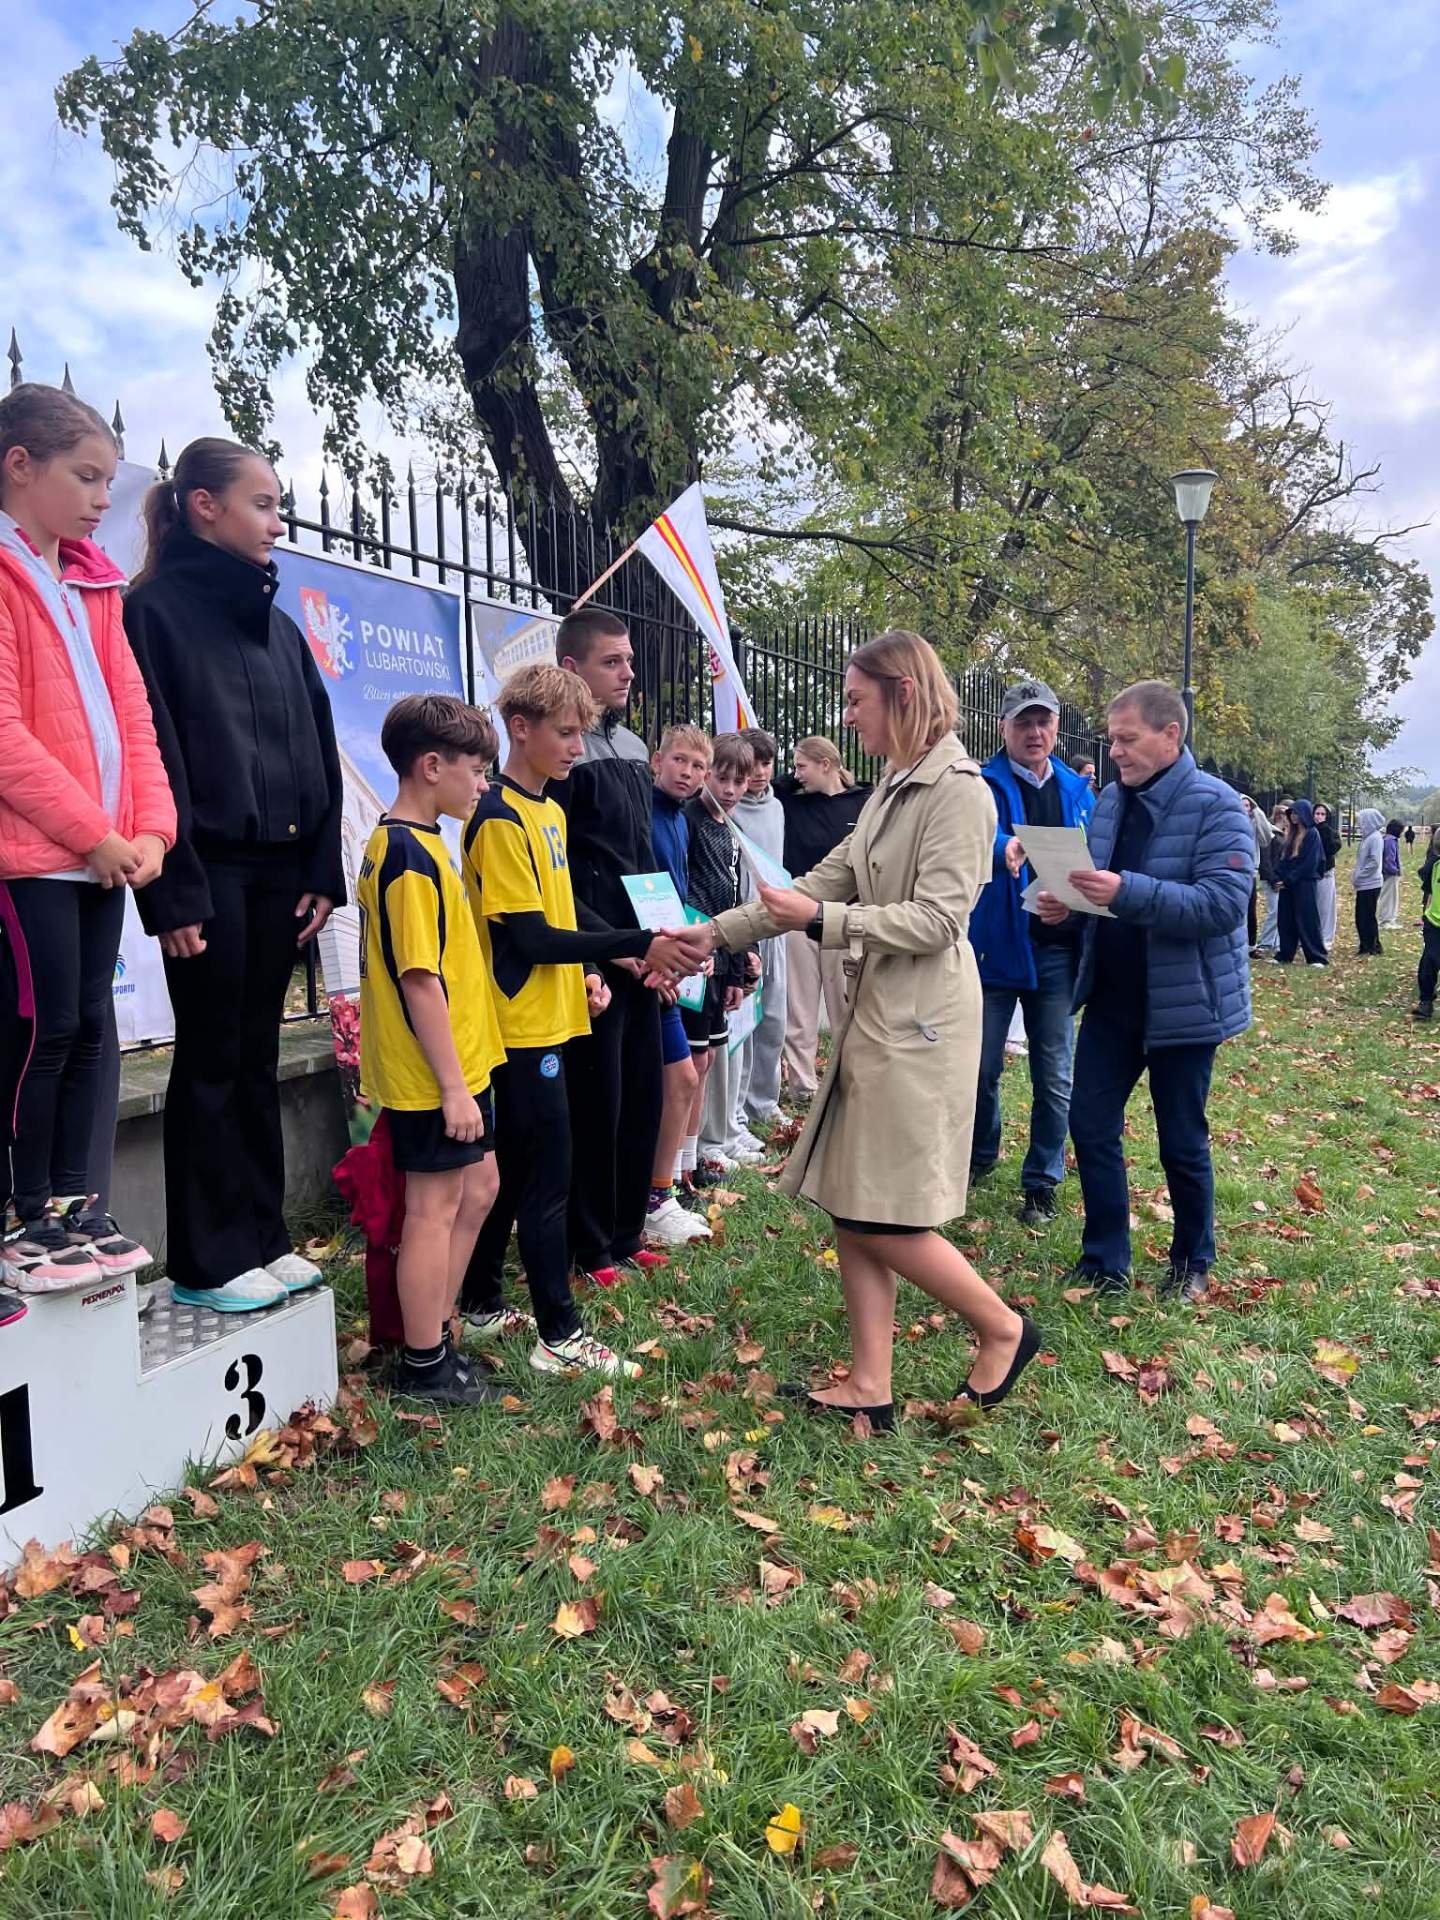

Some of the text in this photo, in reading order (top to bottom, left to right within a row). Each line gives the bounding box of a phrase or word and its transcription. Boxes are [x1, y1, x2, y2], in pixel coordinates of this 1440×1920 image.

[360, 619, 445, 659] POWIAT
[542, 825, 566, 869] 13
[224, 1353, 267, 1441] 3
[0, 1382, 45, 1516] 1
